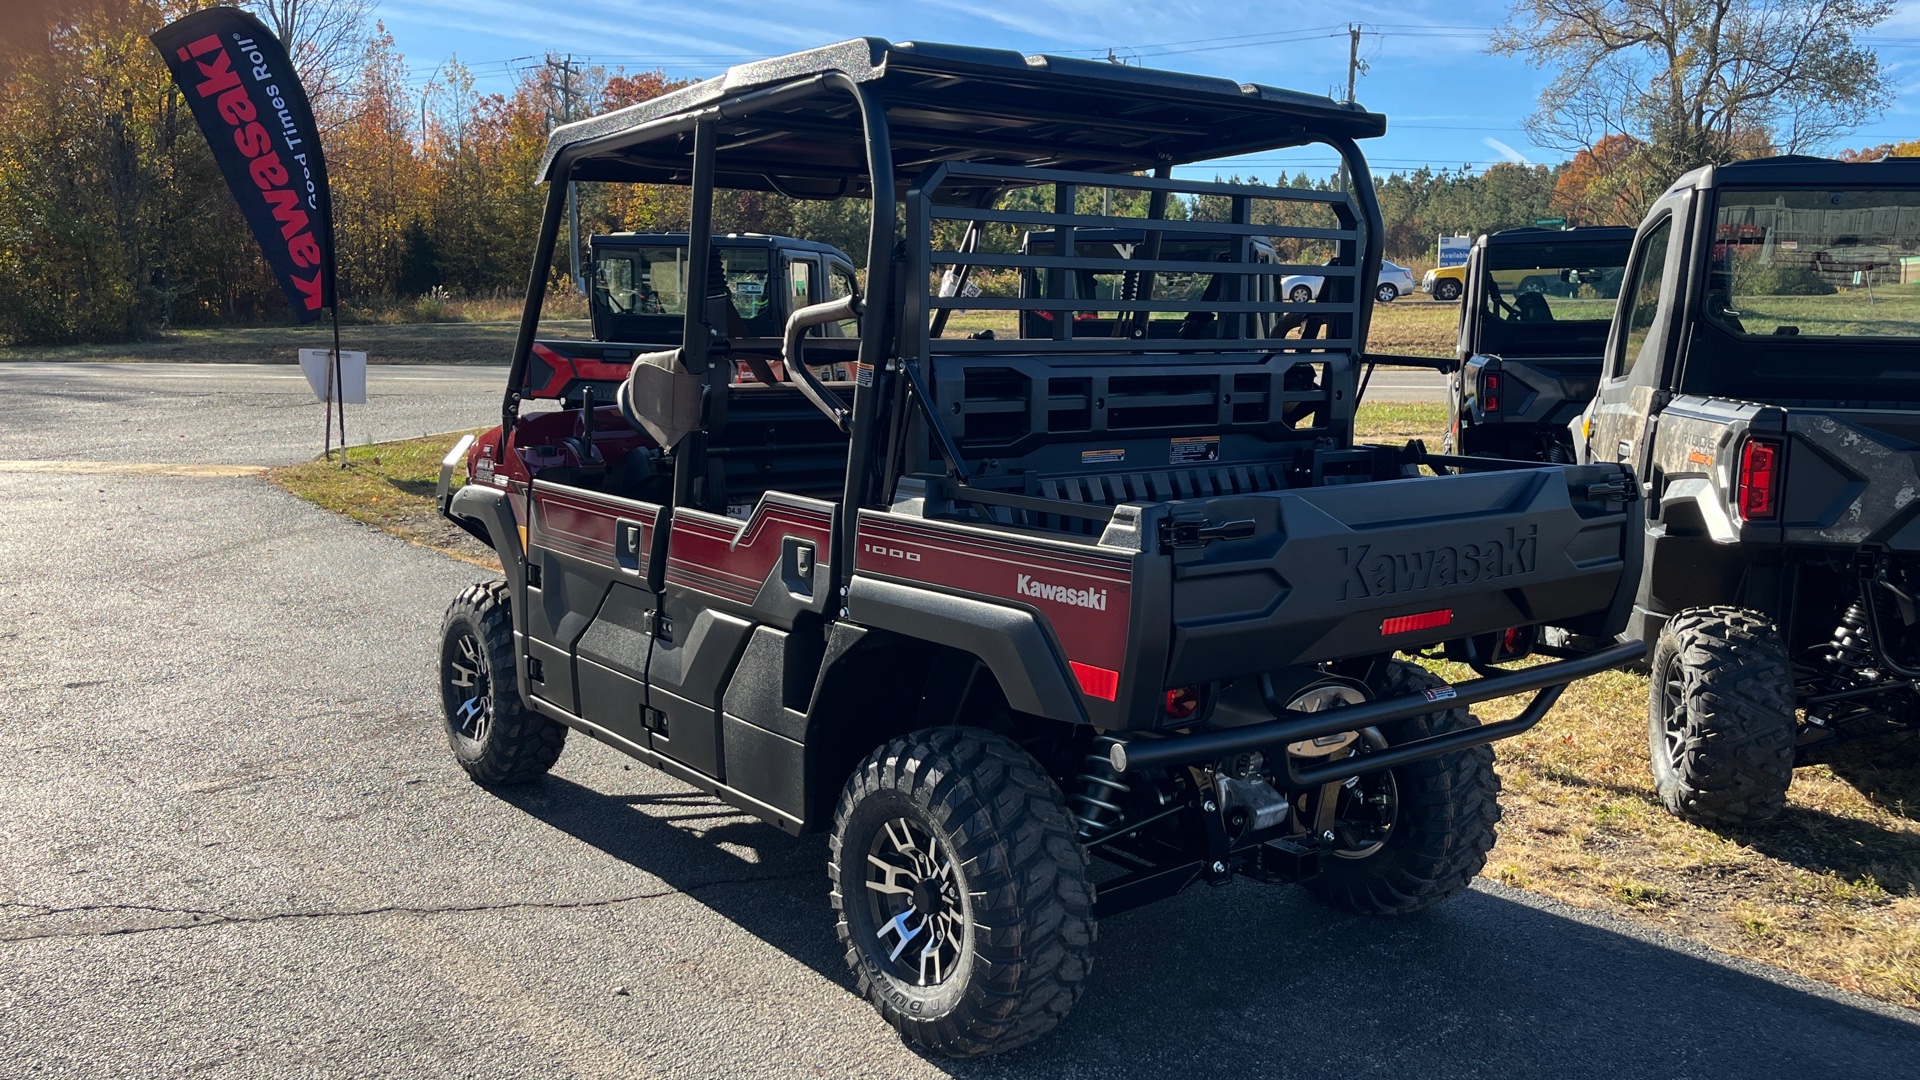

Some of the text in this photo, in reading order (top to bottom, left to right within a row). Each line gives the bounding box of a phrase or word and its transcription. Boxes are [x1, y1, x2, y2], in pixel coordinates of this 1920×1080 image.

[266, 84, 302, 150] Times
[176, 33, 322, 311] Kawasaki
[293, 153, 317, 210] Good
[1440, 251, 1469, 259] Available
[1682, 432, 1715, 450] RIDGE
[864, 543, 921, 562] 1000
[1335, 524, 1538, 601] Kawasaki
[1017, 573, 1107, 611] Kawasaki
